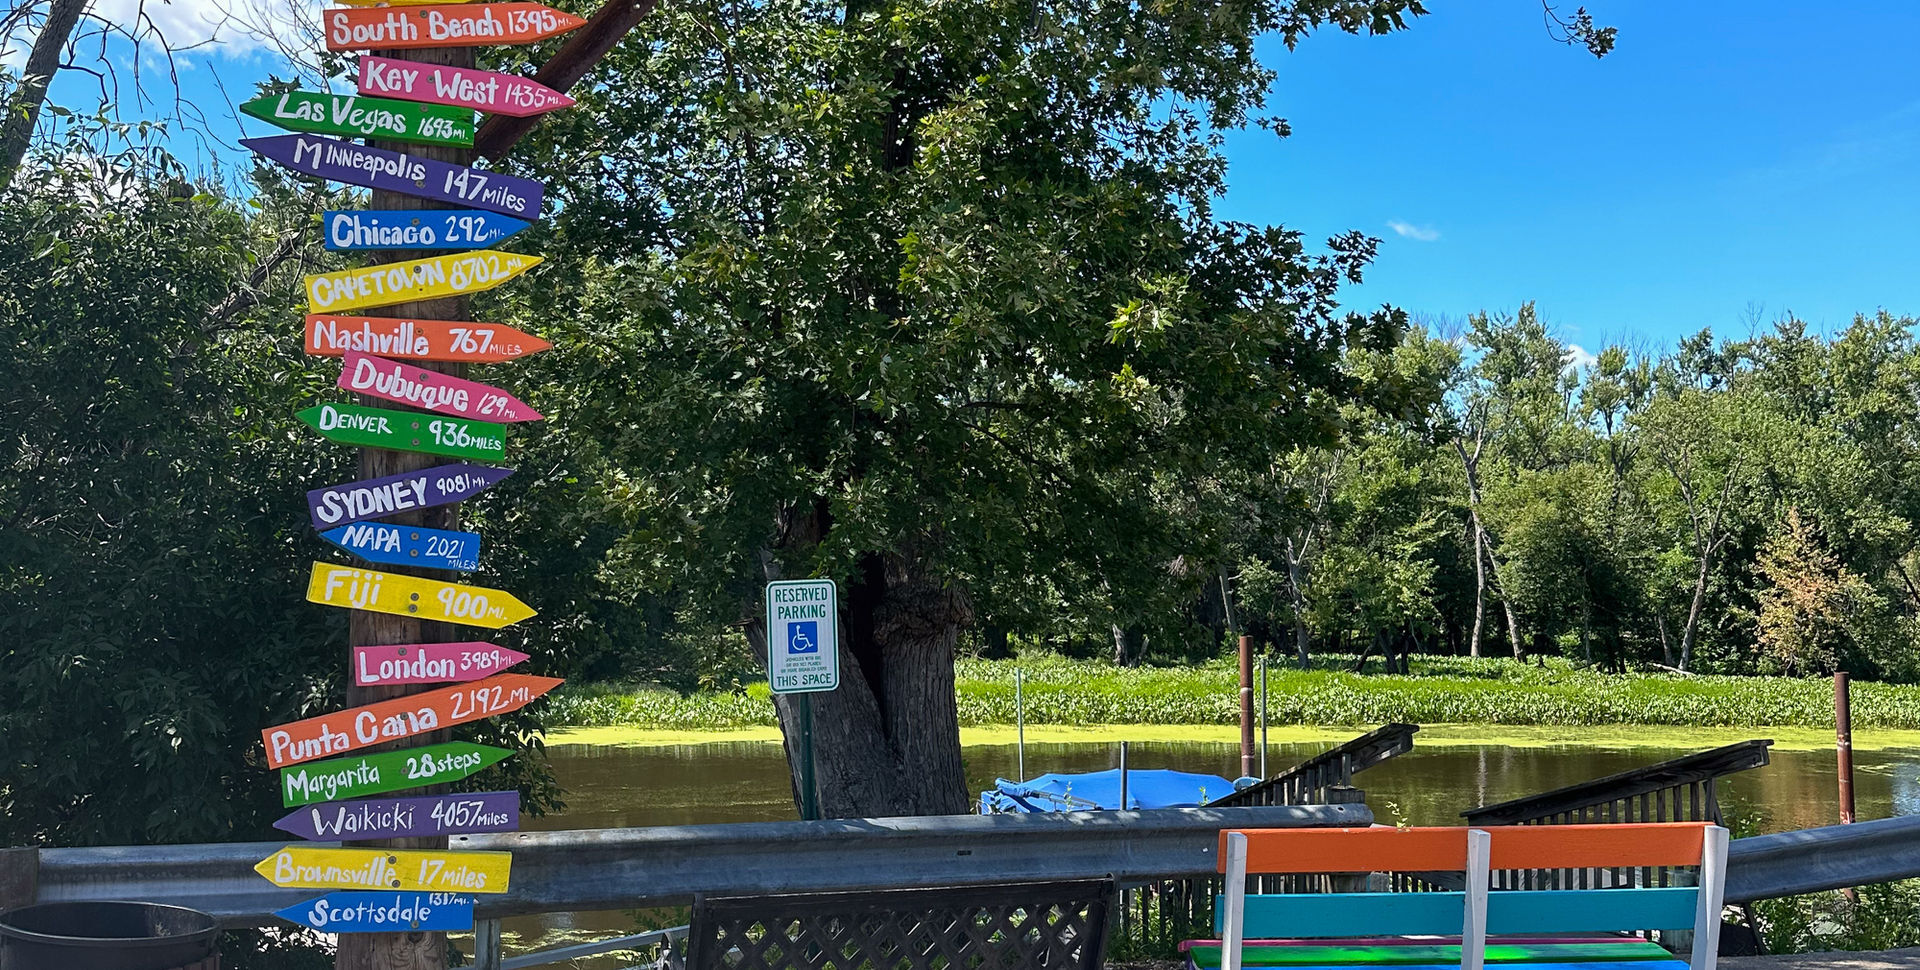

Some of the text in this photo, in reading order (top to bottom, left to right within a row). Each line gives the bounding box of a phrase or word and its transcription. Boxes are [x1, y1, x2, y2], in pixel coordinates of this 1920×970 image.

[332, 12, 417, 45] South
[429, 7, 503, 40] Beach
[434, 69, 500, 104] West
[275, 92, 325, 122] Las
[332, 96, 407, 135] Vegas
[312, 260, 445, 307] CAPETOWN
[313, 320, 429, 355] Nashville
[351, 358, 469, 412] Dubuque
[316, 477, 427, 523] SYDNEY
[341, 525, 465, 559] NAPA 2021
[325, 570, 384, 609] Fiji
[775, 587, 828, 603] RESERVED
[777, 604, 826, 620] PARKING
[359, 649, 455, 683] London
[776, 673, 832, 687] THIS SPACE
[270, 723, 350, 764] Punta
[355, 707, 438, 745] Cana
[286, 759, 380, 800] Margarita
[311, 802, 416, 835] Waikicki
[274, 852, 396, 886] Brownsville
[417, 859, 445, 885] 17
[308, 894, 431, 927] Scottsdale
